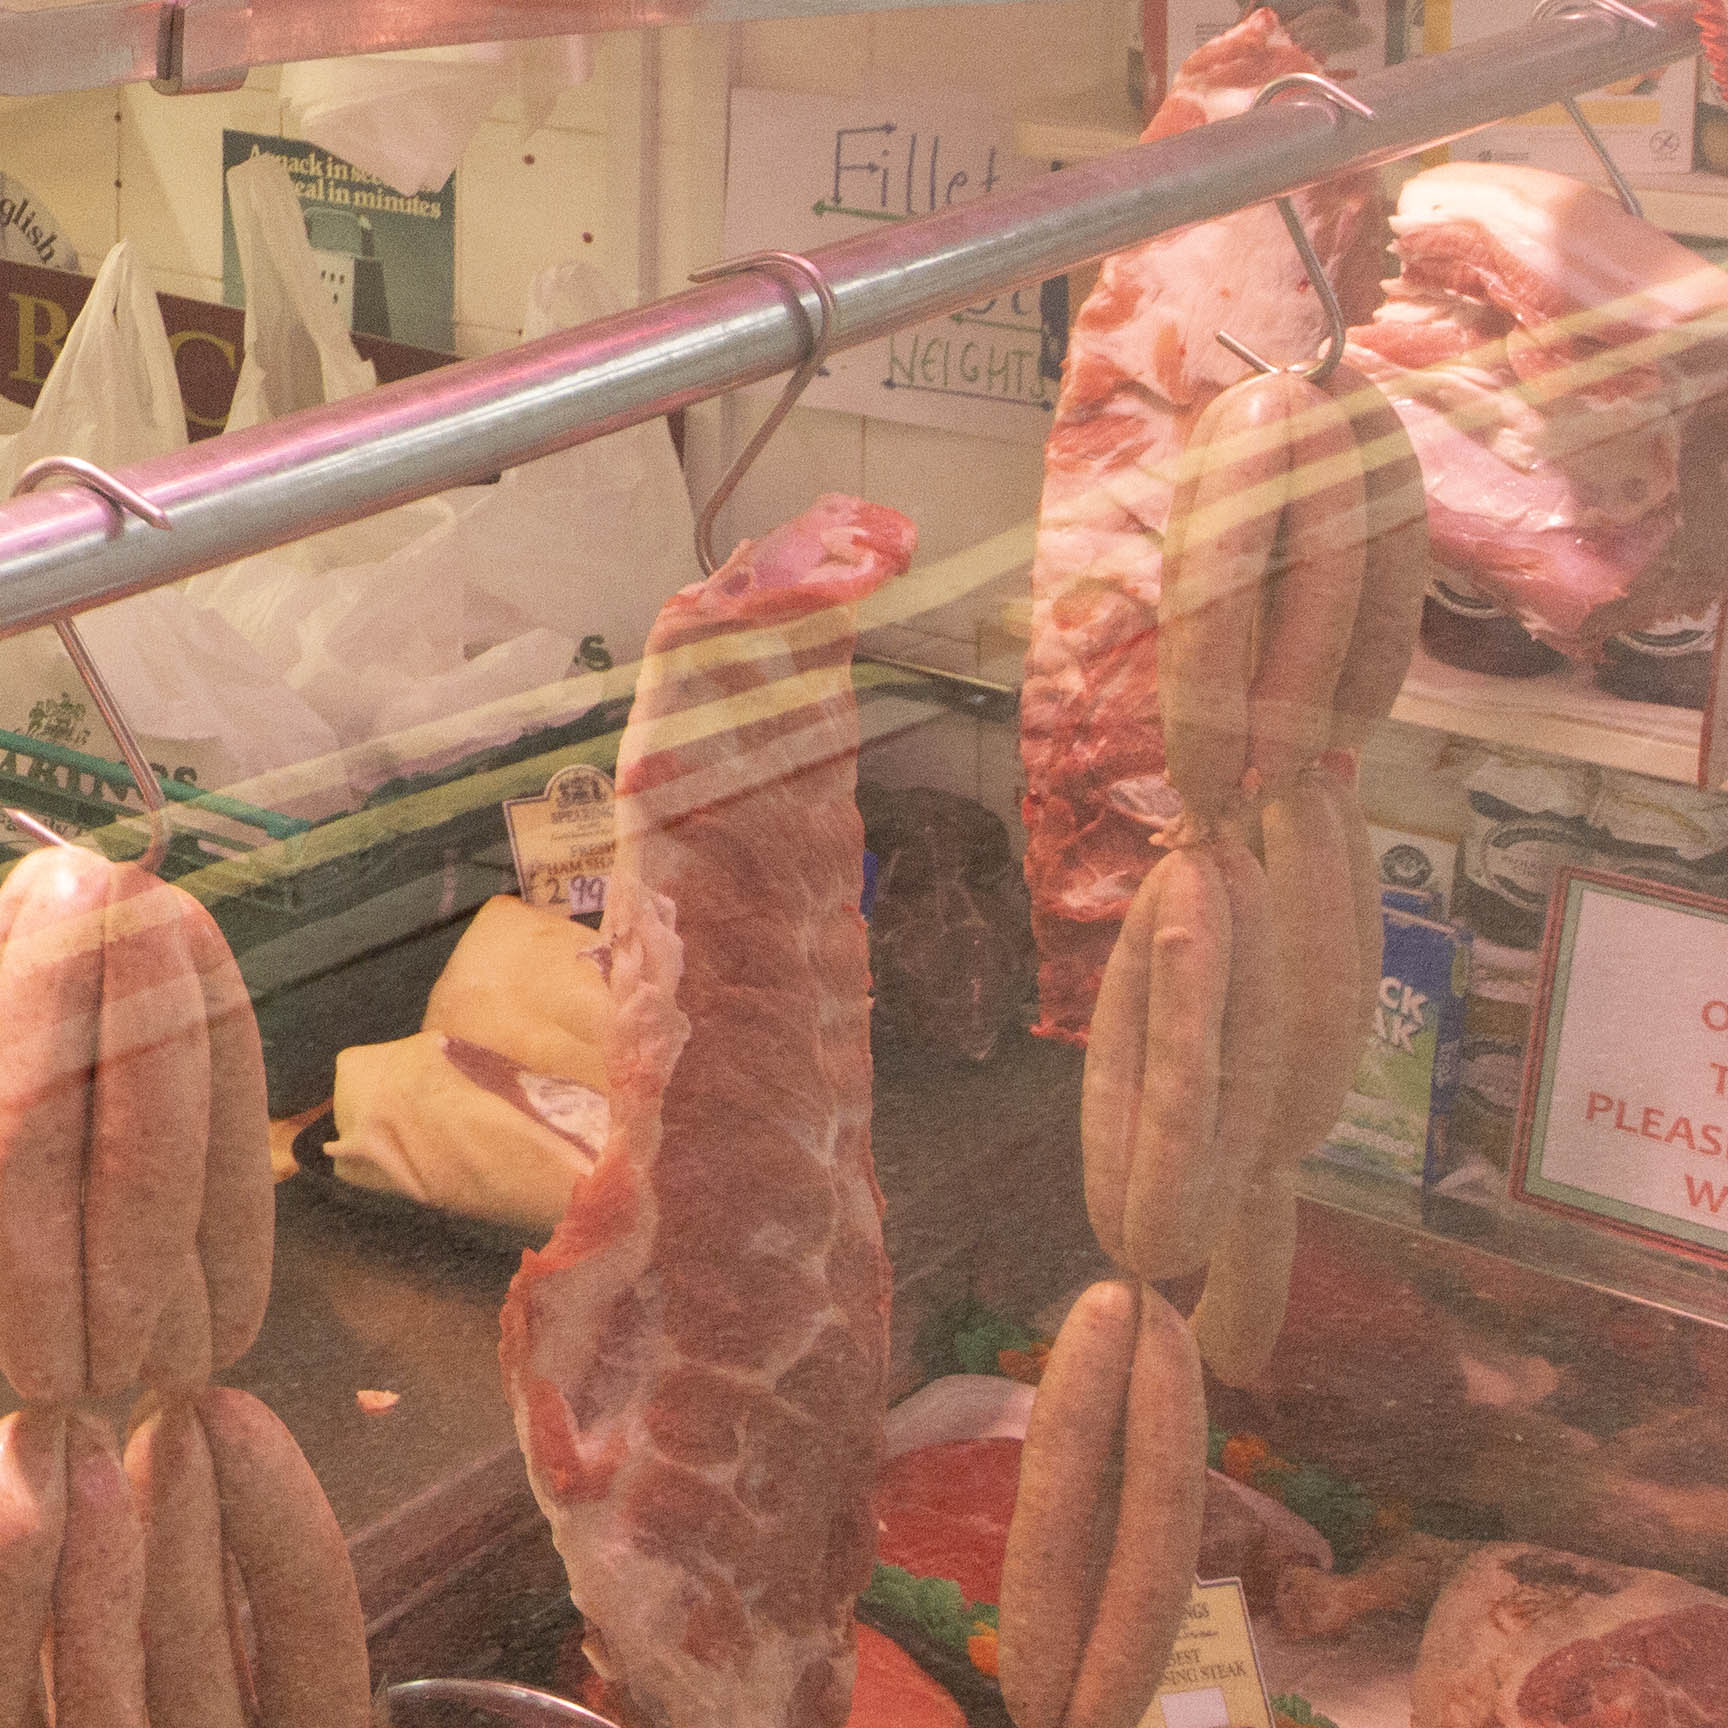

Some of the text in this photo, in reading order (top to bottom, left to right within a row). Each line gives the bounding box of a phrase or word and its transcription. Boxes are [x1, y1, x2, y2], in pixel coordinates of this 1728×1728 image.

[326, 155, 347, 181] in
[831, 123, 1000, 216] Fillet
[327, 181, 442, 220] in minutes
